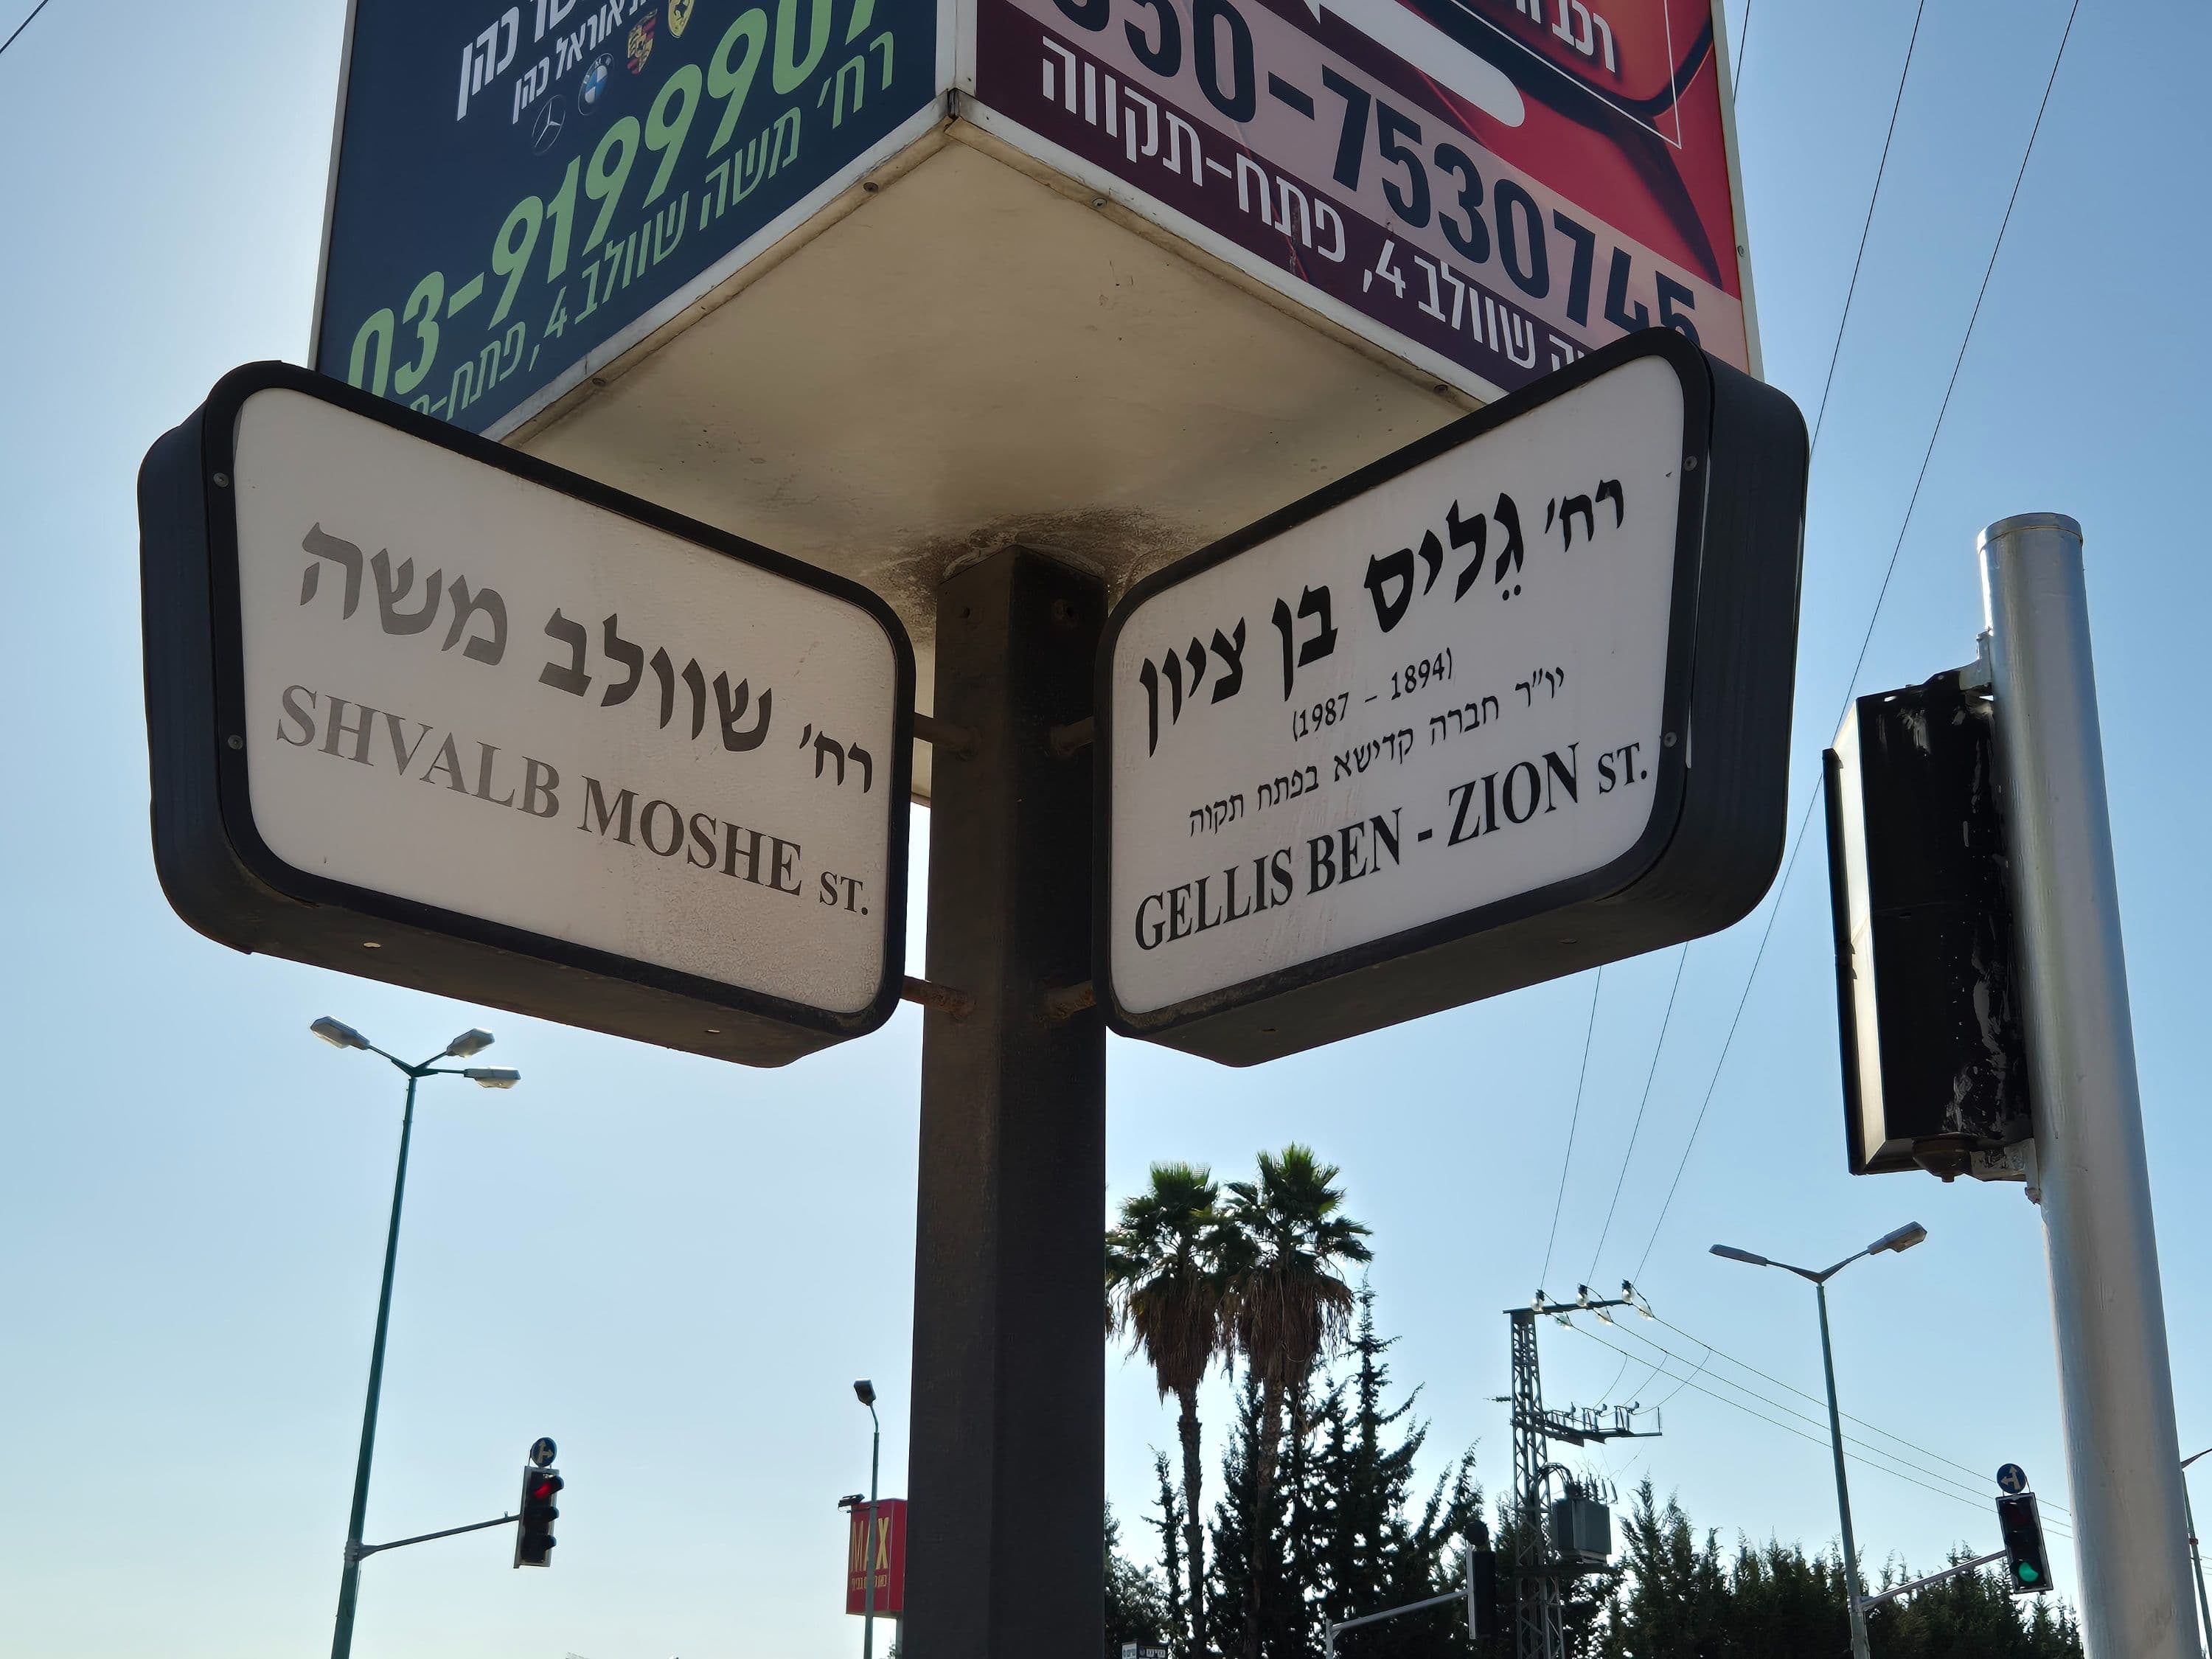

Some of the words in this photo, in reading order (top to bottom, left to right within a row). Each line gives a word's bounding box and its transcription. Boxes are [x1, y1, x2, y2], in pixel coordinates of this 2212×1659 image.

[456, 6, 520, 122] כהן
[512, 56, 550, 124] כהן
[699, 107, 801, 231] משה
[1043, 35, 1346, 262] פתח-תקווה
[1052, 0, 1703, 345] 50-7530745
[574, 191, 689, 324] שוולב
[1413, 255, 1537, 369] שוולב
[299, 522, 509, 667] משה
[1271, 585, 1338, 702] בן
[538, 607, 773, 752] שוולב
[1139, 616, 1246, 758] ציון
[1430, 695, 1500, 746] חברה
[276, 685, 560, 819] SHVALB
[577, 776, 802, 897] MOSHE
[819, 872, 869, 916] ST.
[1189, 793, 1245, 837] תקוה
[1257, 765, 1319, 811] בפתח
[1333, 728, 1413, 782] קדישא
[1135, 847, 1294, 950] GELLIS
[1307, 807, 1402, 896] BEN
[1447, 743, 1579, 846] ZION
[1598, 742, 1648, 796] ST.
